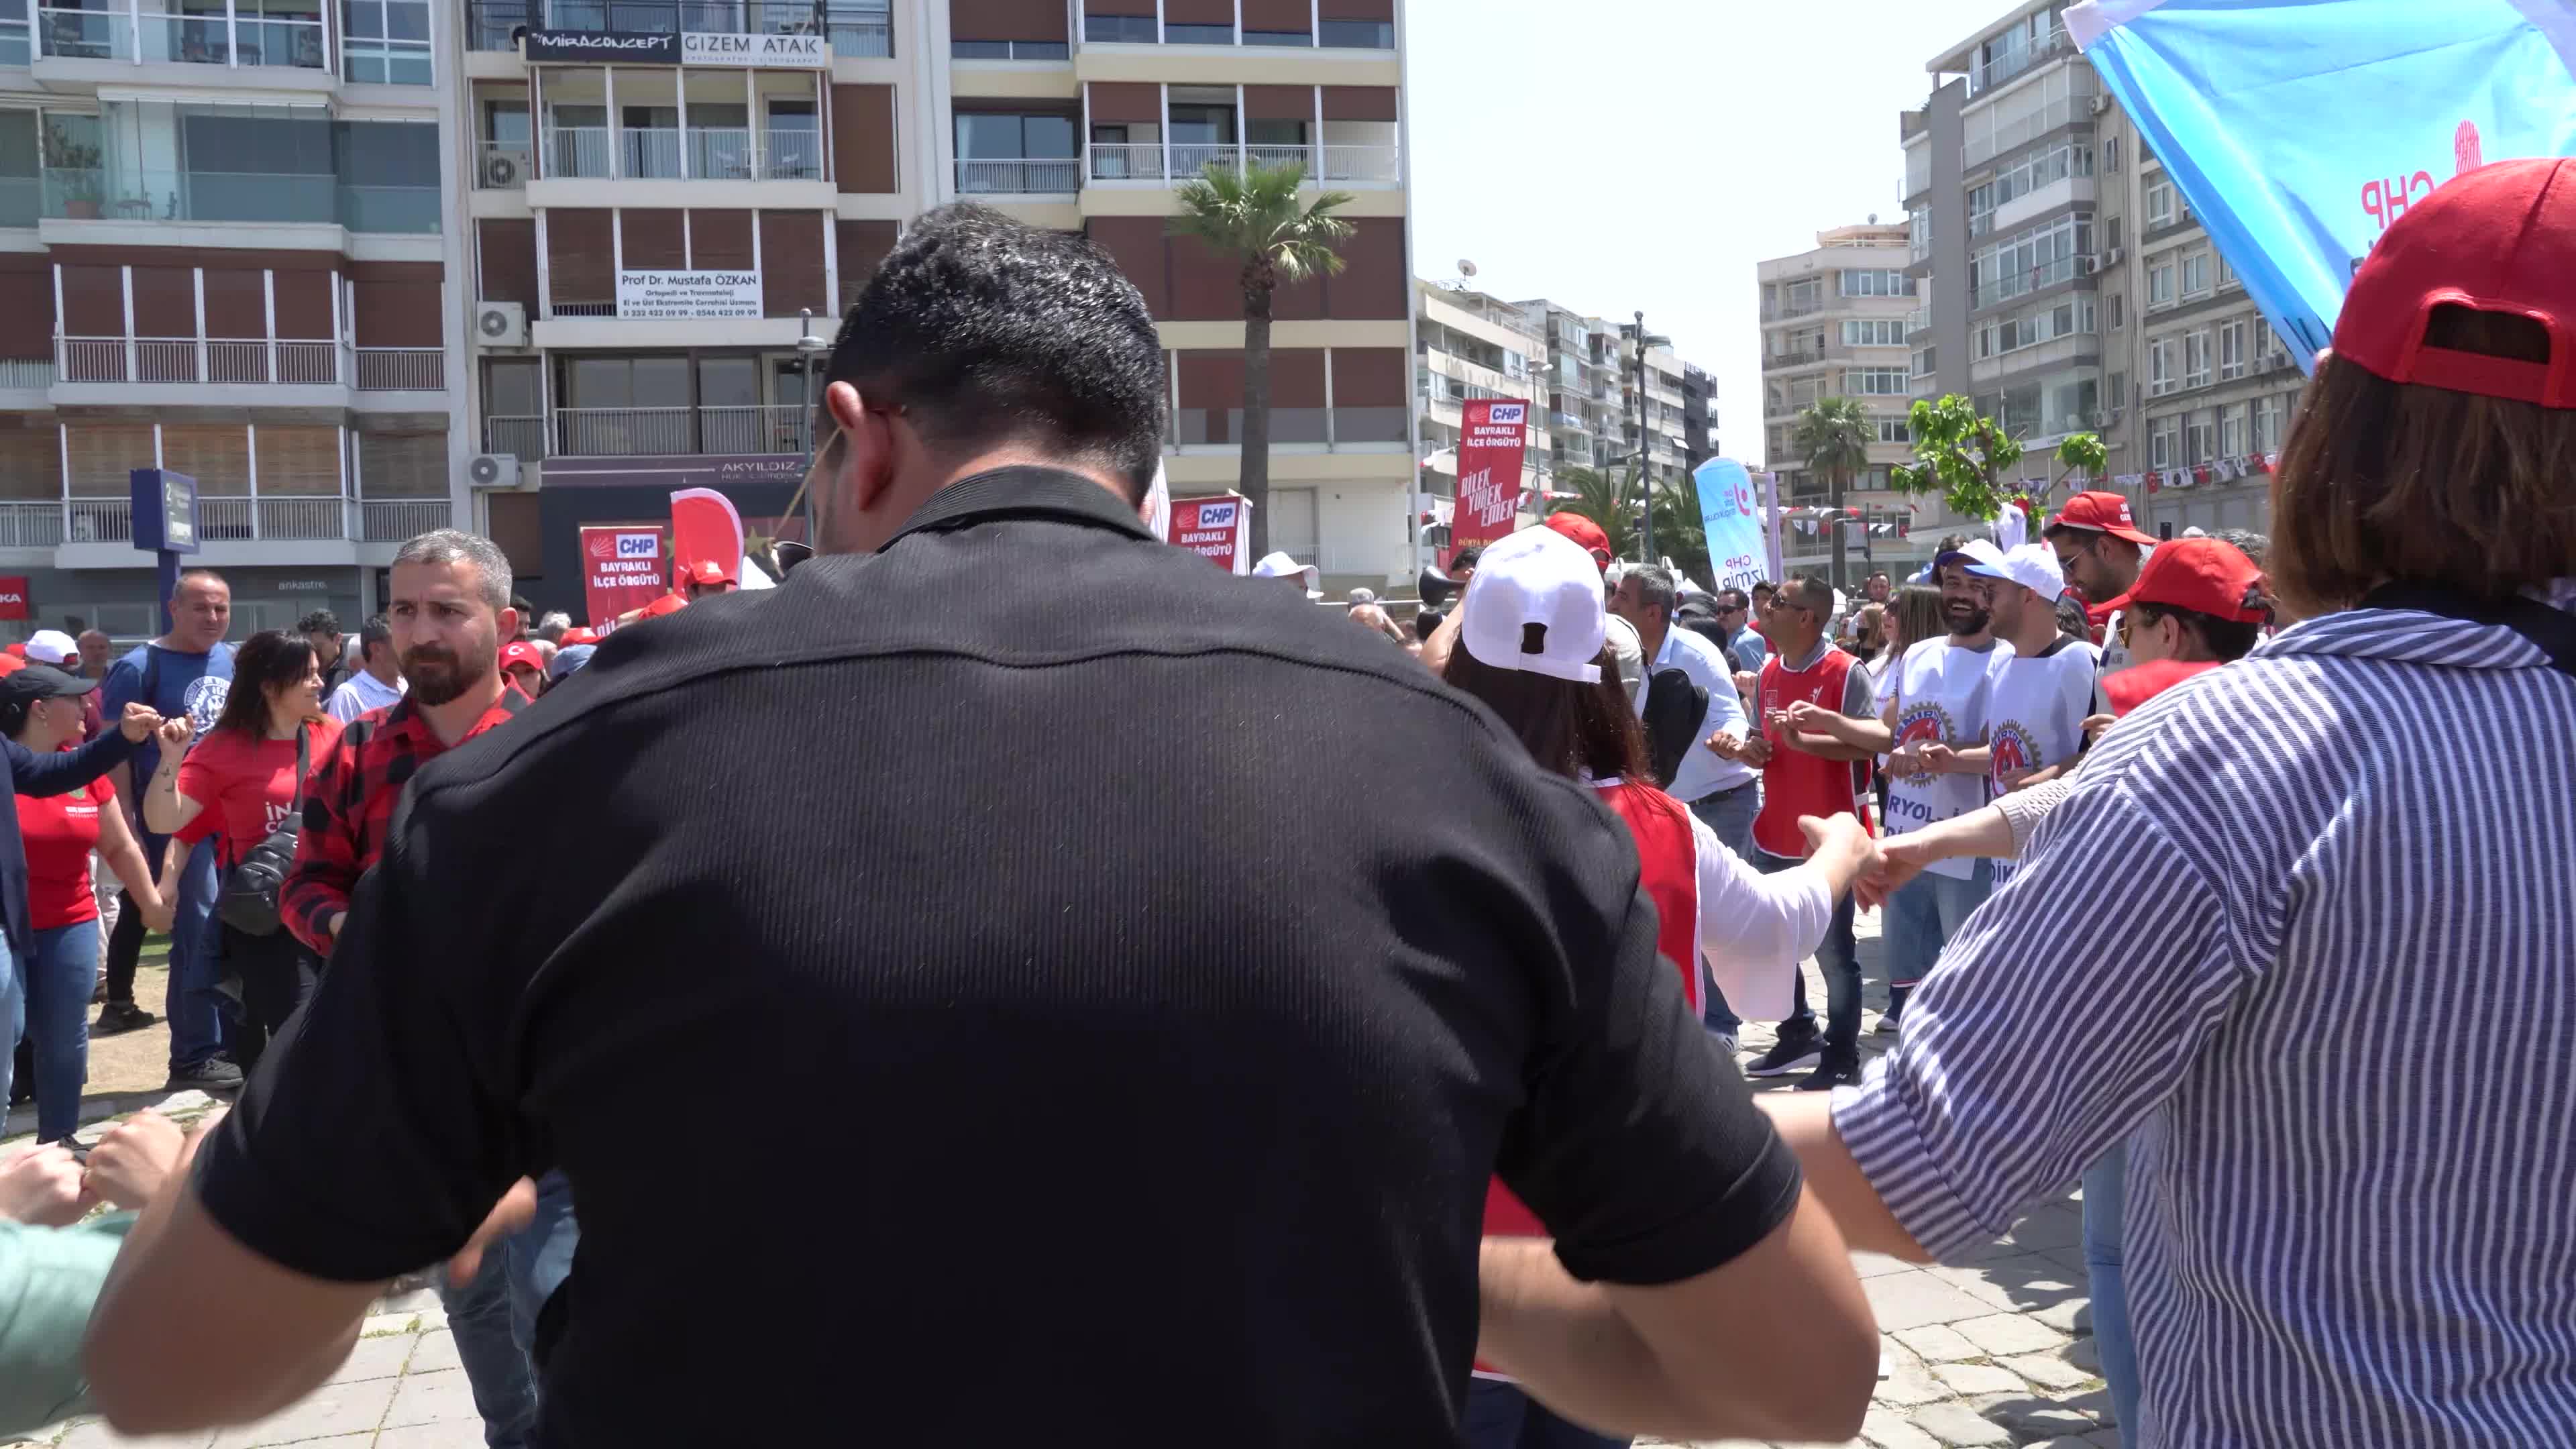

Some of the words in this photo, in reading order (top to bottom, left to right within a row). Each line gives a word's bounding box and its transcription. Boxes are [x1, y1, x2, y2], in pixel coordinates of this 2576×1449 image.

[685, 36, 750, 52] GIZEM
[763, 38, 817, 54] ATAK
[623, 275, 645, 285] Prof
[649, 275, 664, 285] Dr.
[668, 276, 711, 285] Mustafa
[715, 274, 757, 285] ÖZKAN
[1493, 408, 1521, 421] CHP
[1474, 427, 1515, 435] BAYRAKLI
[1467, 437, 1485, 448] İLÇE
[1487, 437, 1521, 447] ÖRGÜTÜ
[722, 461, 795, 472] AKYILDIZ
[1201, 508, 1233, 524] CHP
[1181, 531, 1226, 543] BAYRAKLI
[620, 539, 655, 553] CHP
[600, 561, 651, 572] BAYRAKLI
[593, 575, 616, 588] İLÇE
[619, 574, 660, 586] ÖRGÜTÜ
